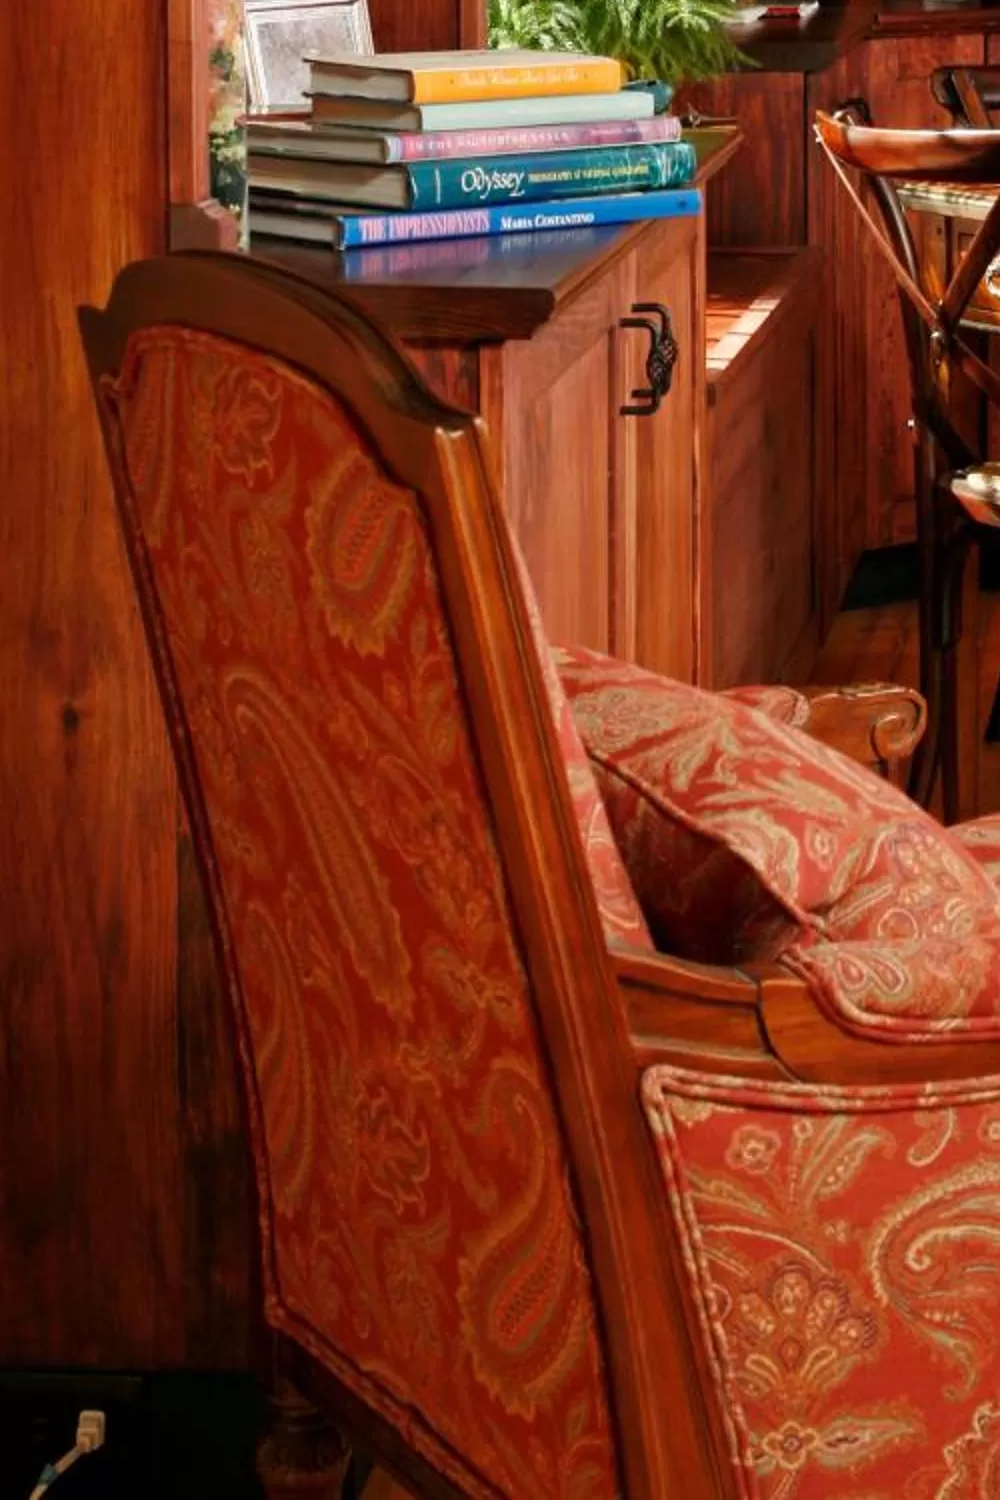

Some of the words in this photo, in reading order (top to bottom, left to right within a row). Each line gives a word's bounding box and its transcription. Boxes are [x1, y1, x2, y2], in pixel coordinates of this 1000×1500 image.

[461, 166, 526, 200] Odyssey
[358, 218, 386, 241] THE
[389, 210, 490, 239] IMPRESSIONISTS
[499, 215, 533, 230] MARIA
[534, 212, 595, 228] COSTANTINO
